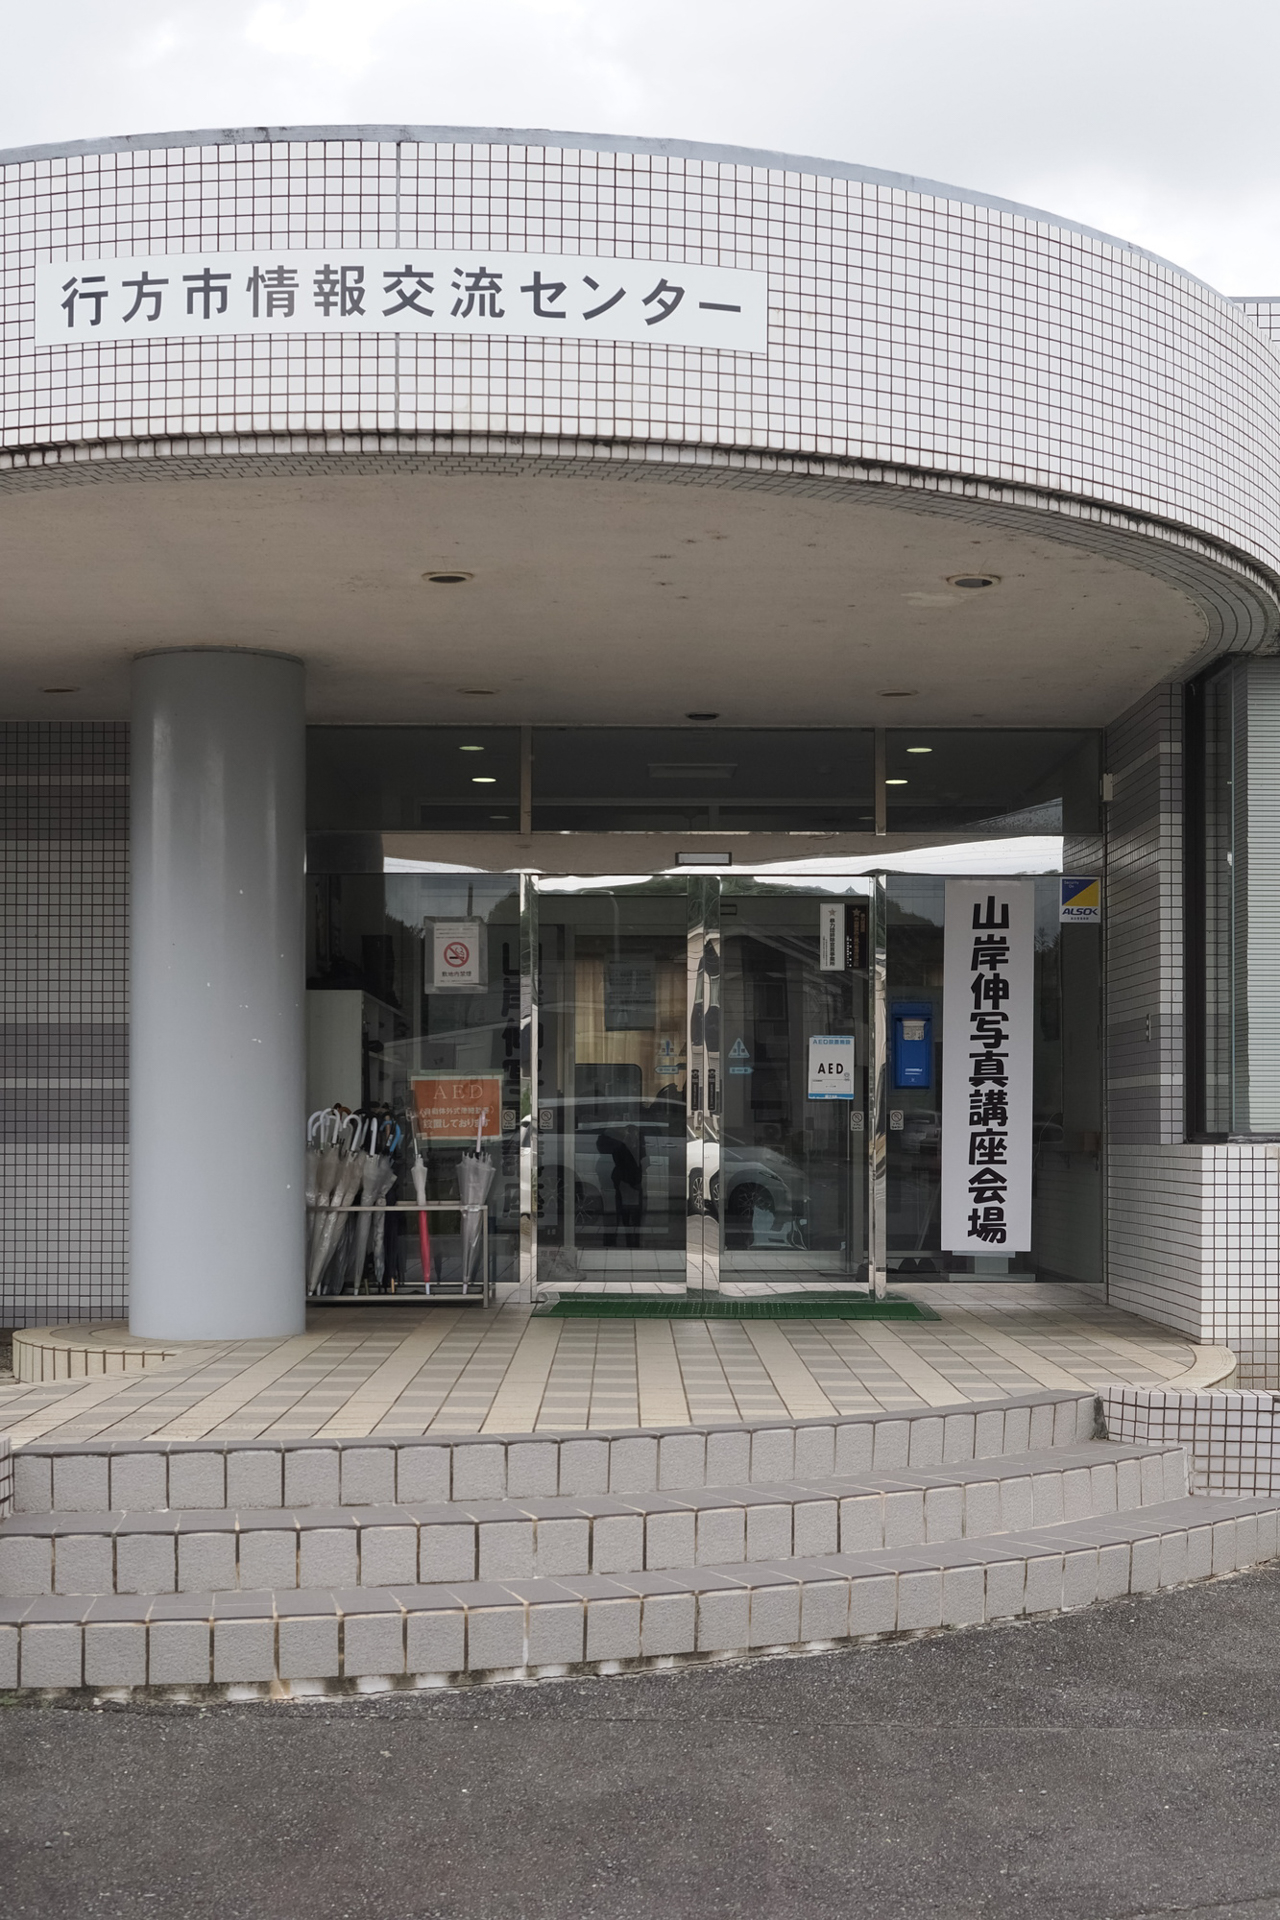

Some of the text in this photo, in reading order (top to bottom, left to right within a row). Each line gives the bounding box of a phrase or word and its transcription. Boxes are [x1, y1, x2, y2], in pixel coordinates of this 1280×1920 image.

[61, 264, 742, 328] 行方市情報交流センター
[817, 1063, 844, 1074] AED
[967, 895, 1010, 1244] 山岸伸写真講座会場
[433, 1084, 483, 1099] AED
